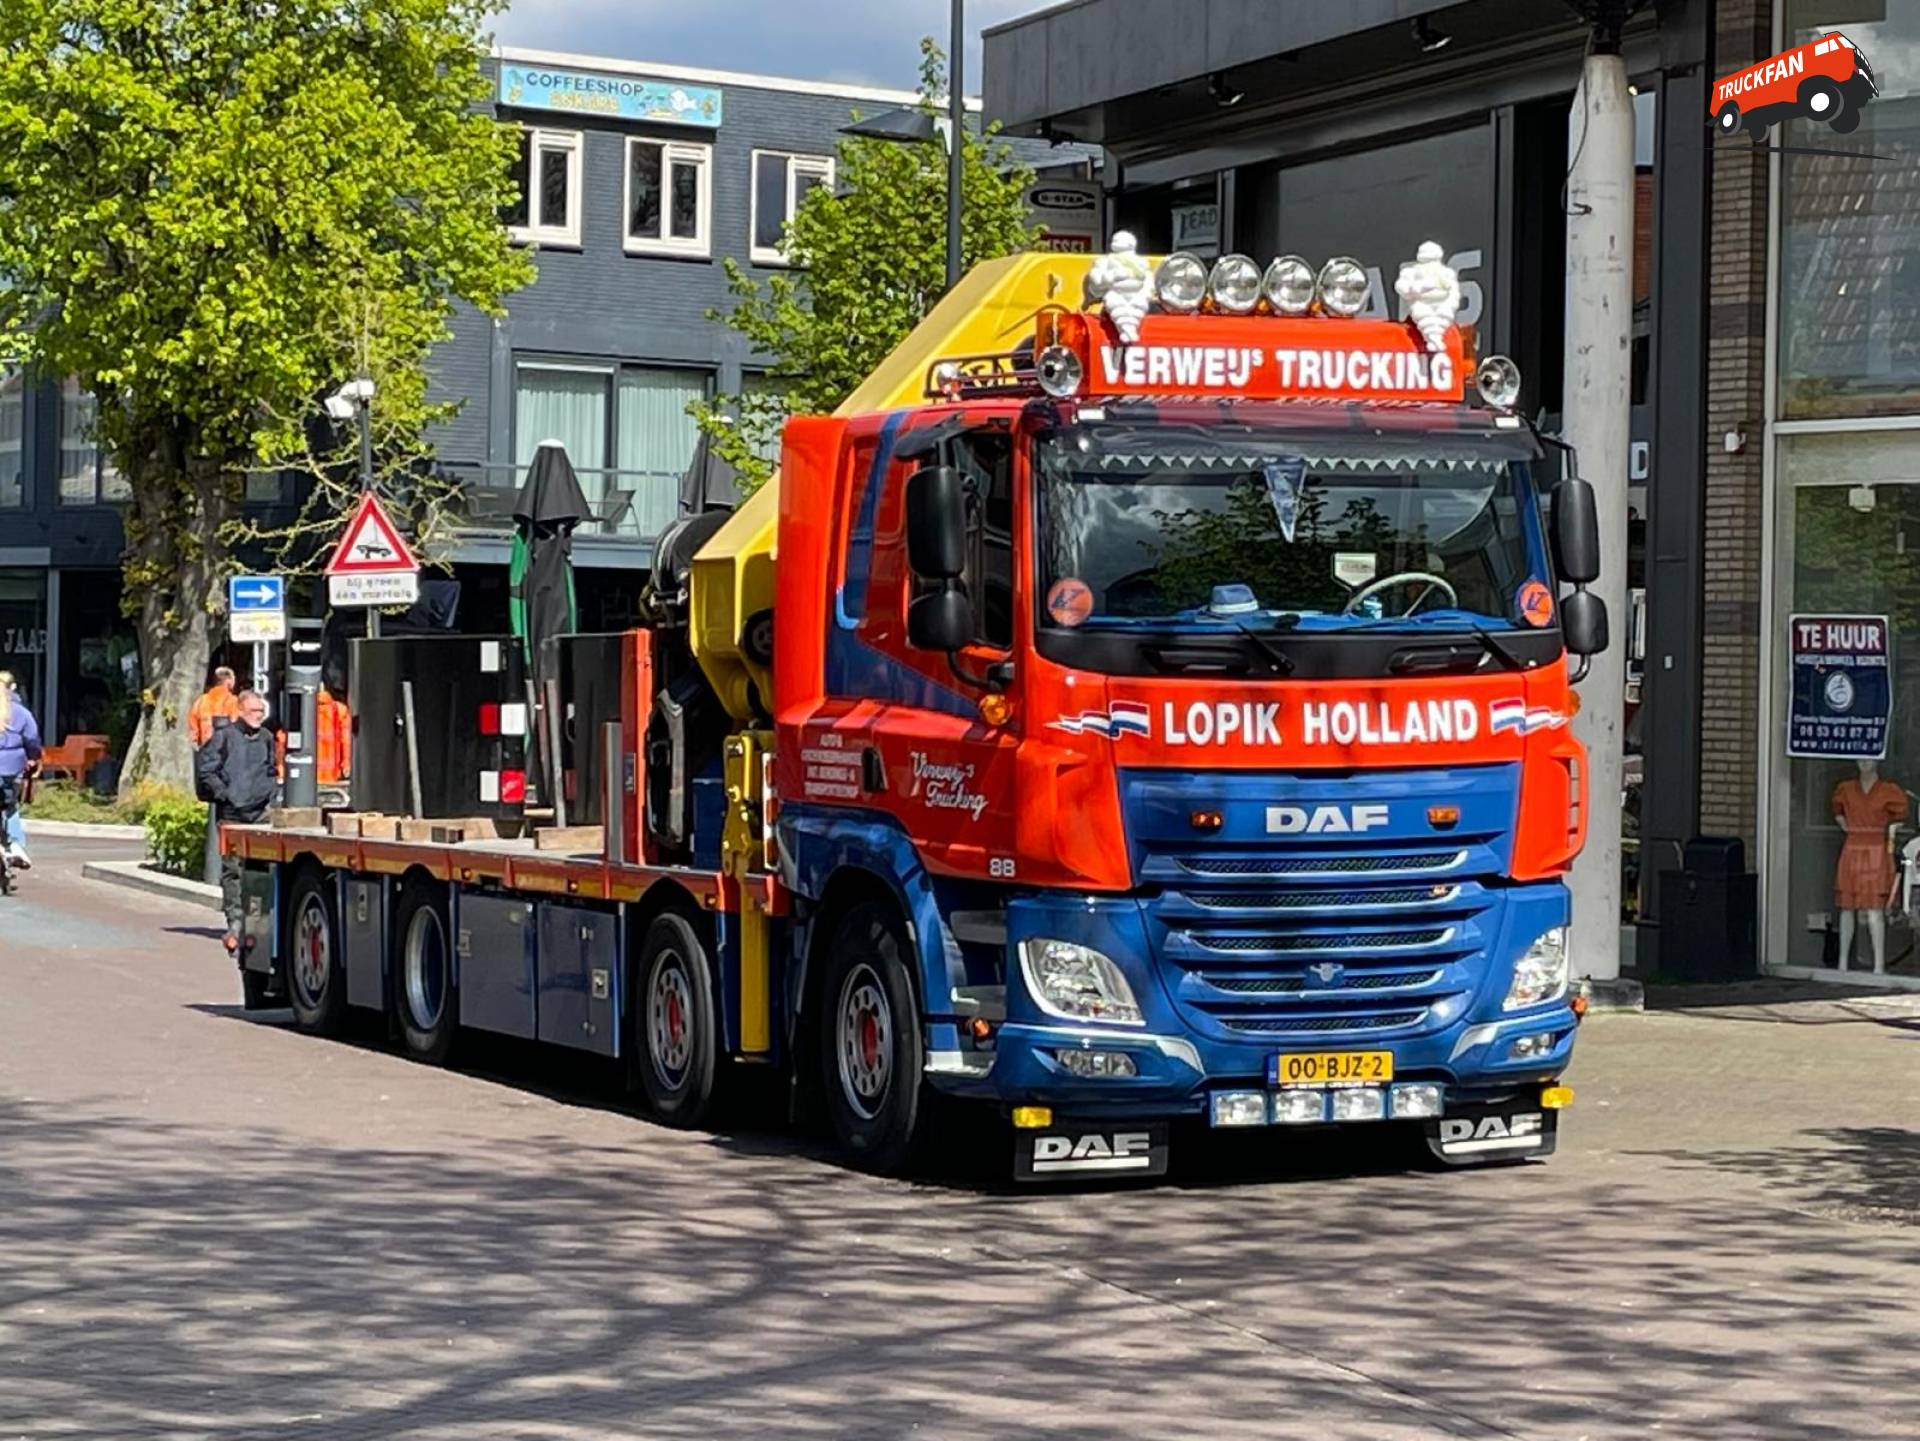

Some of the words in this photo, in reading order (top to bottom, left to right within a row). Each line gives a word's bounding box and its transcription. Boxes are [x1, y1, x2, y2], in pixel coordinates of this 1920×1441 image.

[526, 71, 644, 97] COFFEESHOP
[1276, 349, 1454, 391] TRUCKING
[1798, 624, 1822, 649] TE
[1826, 624, 1881, 649] HUUR
[1164, 702, 1282, 745] LOPIK
[1303, 699, 1478, 744] HOLLAND
[1266, 805, 1389, 834] DAF
[1288, 1056, 1383, 1079] 00-BJZ-2
[1440, 1113, 1542, 1143] DAF
[1034, 1132, 1150, 1160] DAF
